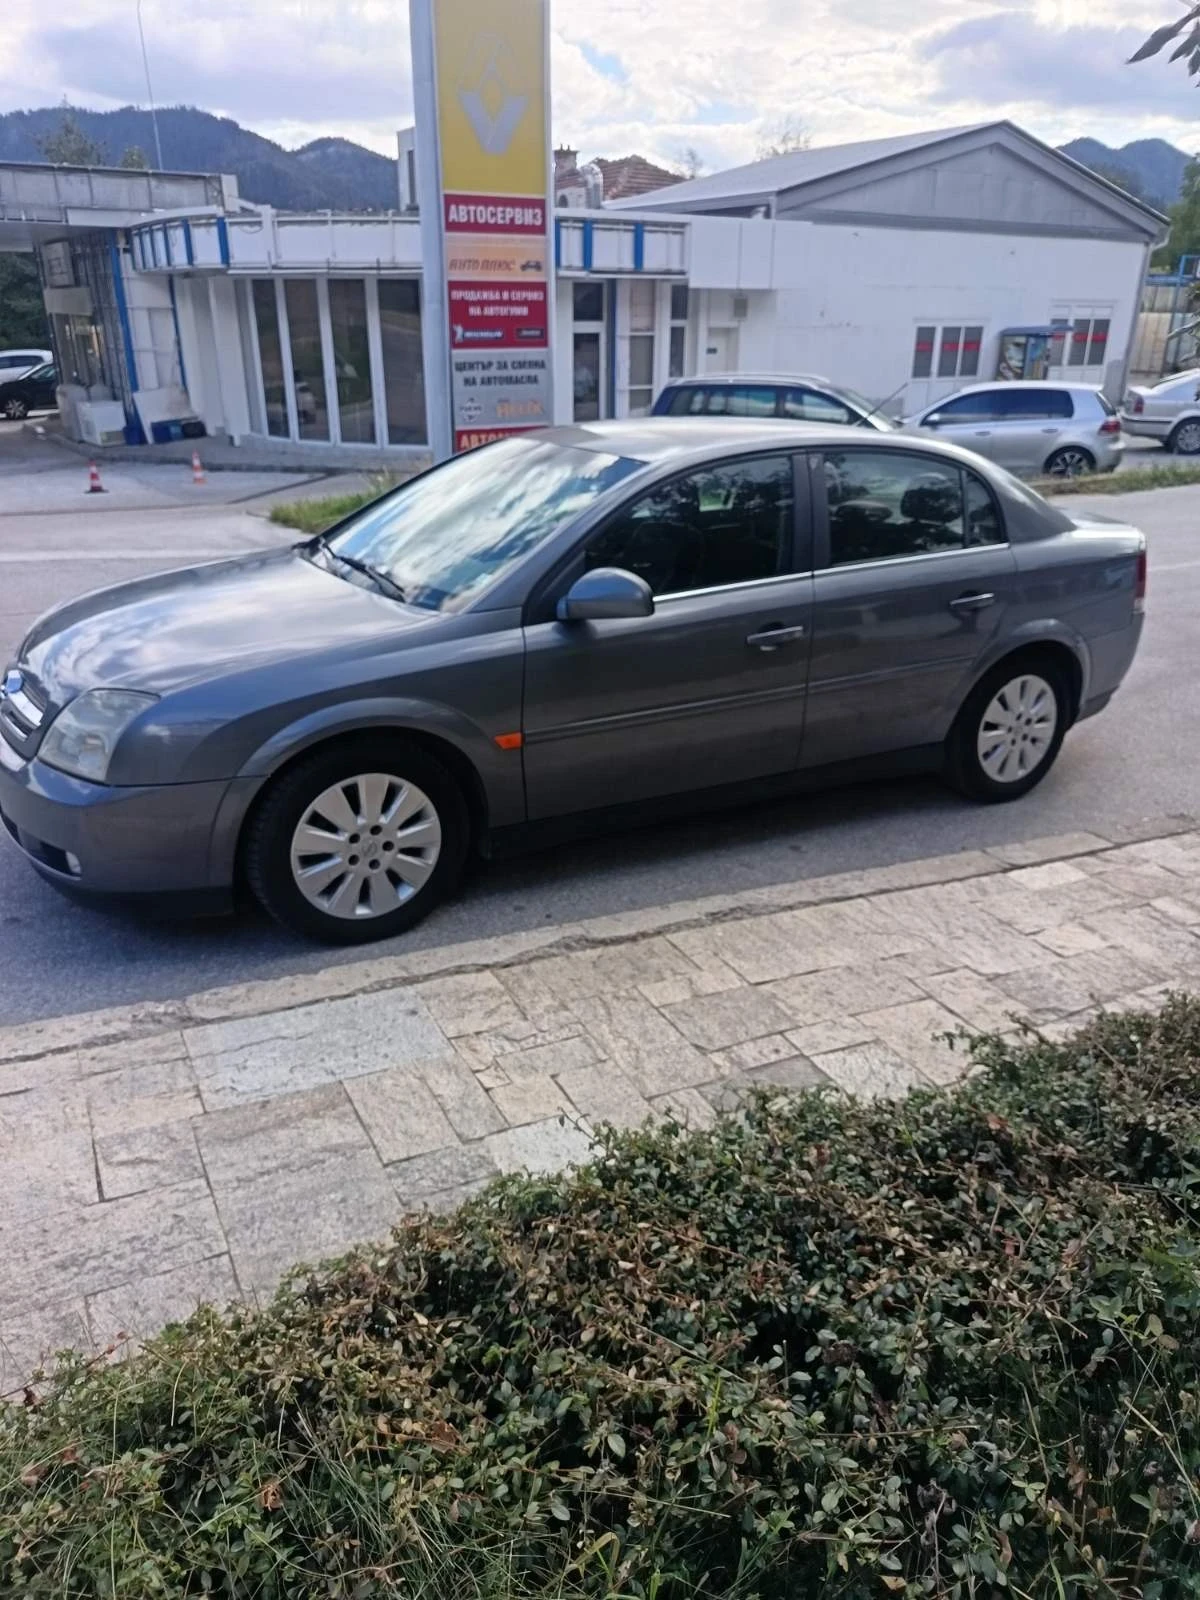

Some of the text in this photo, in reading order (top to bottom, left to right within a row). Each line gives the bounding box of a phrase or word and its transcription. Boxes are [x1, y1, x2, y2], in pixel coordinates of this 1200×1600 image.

[448, 204, 543, 226] АВТОСЕРВИЗ
[468, 306, 481, 316] НА
[455, 361, 494, 372] ЦЕНТЪР
[496, 361, 508, 370] ЗА
[464, 376, 477, 386] НА
